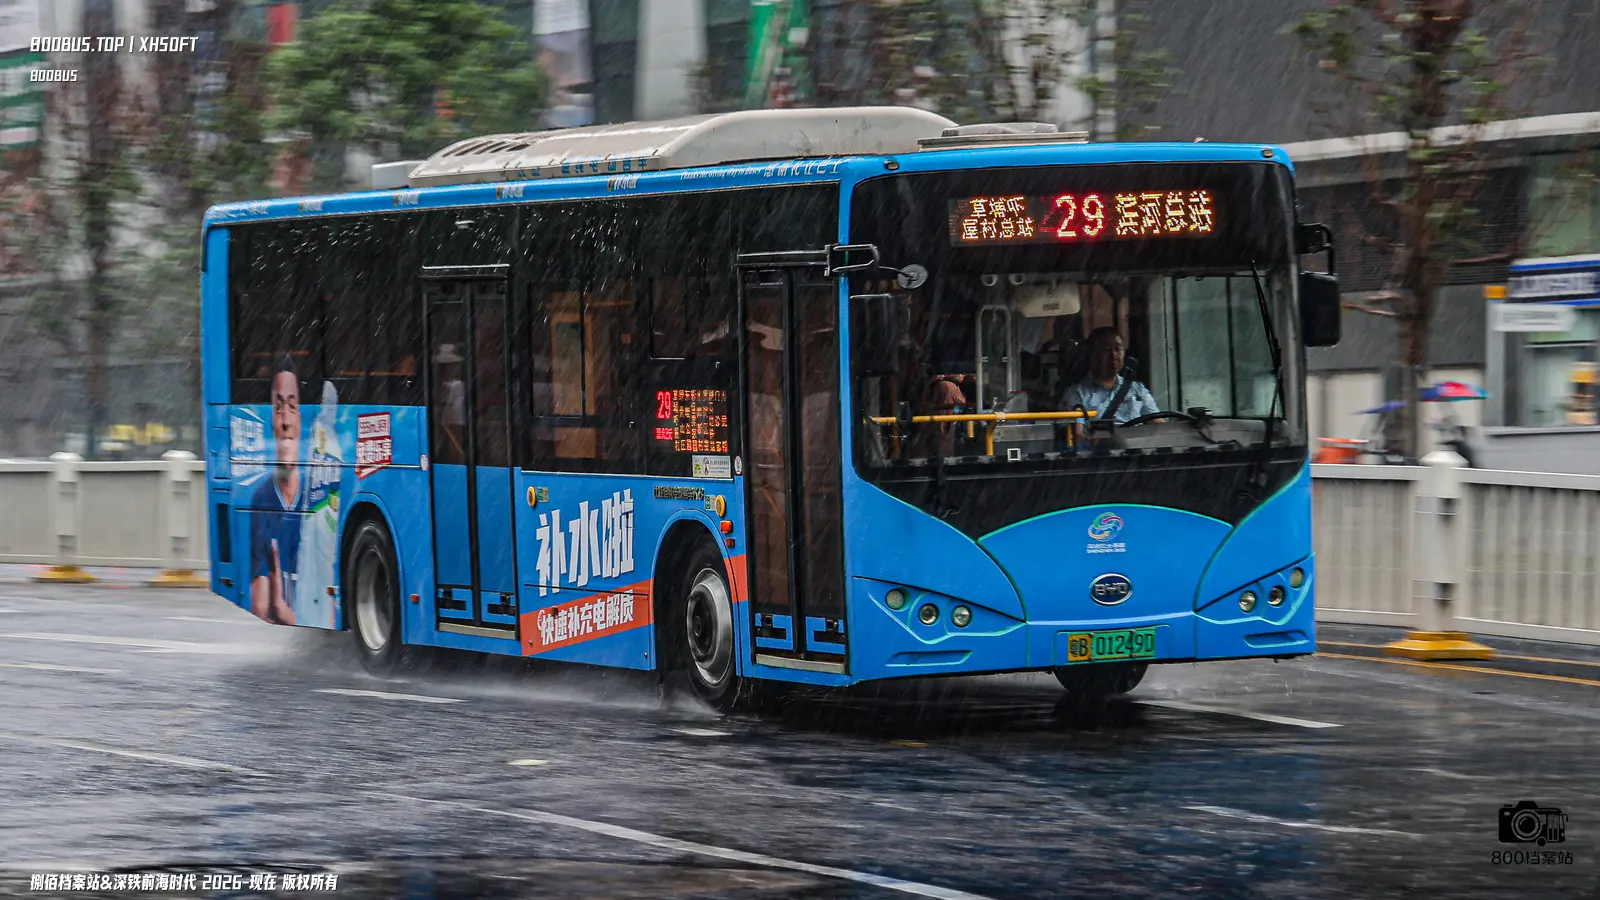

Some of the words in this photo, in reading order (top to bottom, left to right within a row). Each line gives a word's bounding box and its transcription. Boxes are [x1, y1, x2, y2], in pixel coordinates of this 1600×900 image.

[1055, 193, 1105, 238] 29
[657, 391, 672, 419] 29
[535, 488, 634, 597] 补水啦
[1094, 582, 1129, 596] BYD
[540, 589, 634, 645] 快速补充电解质
